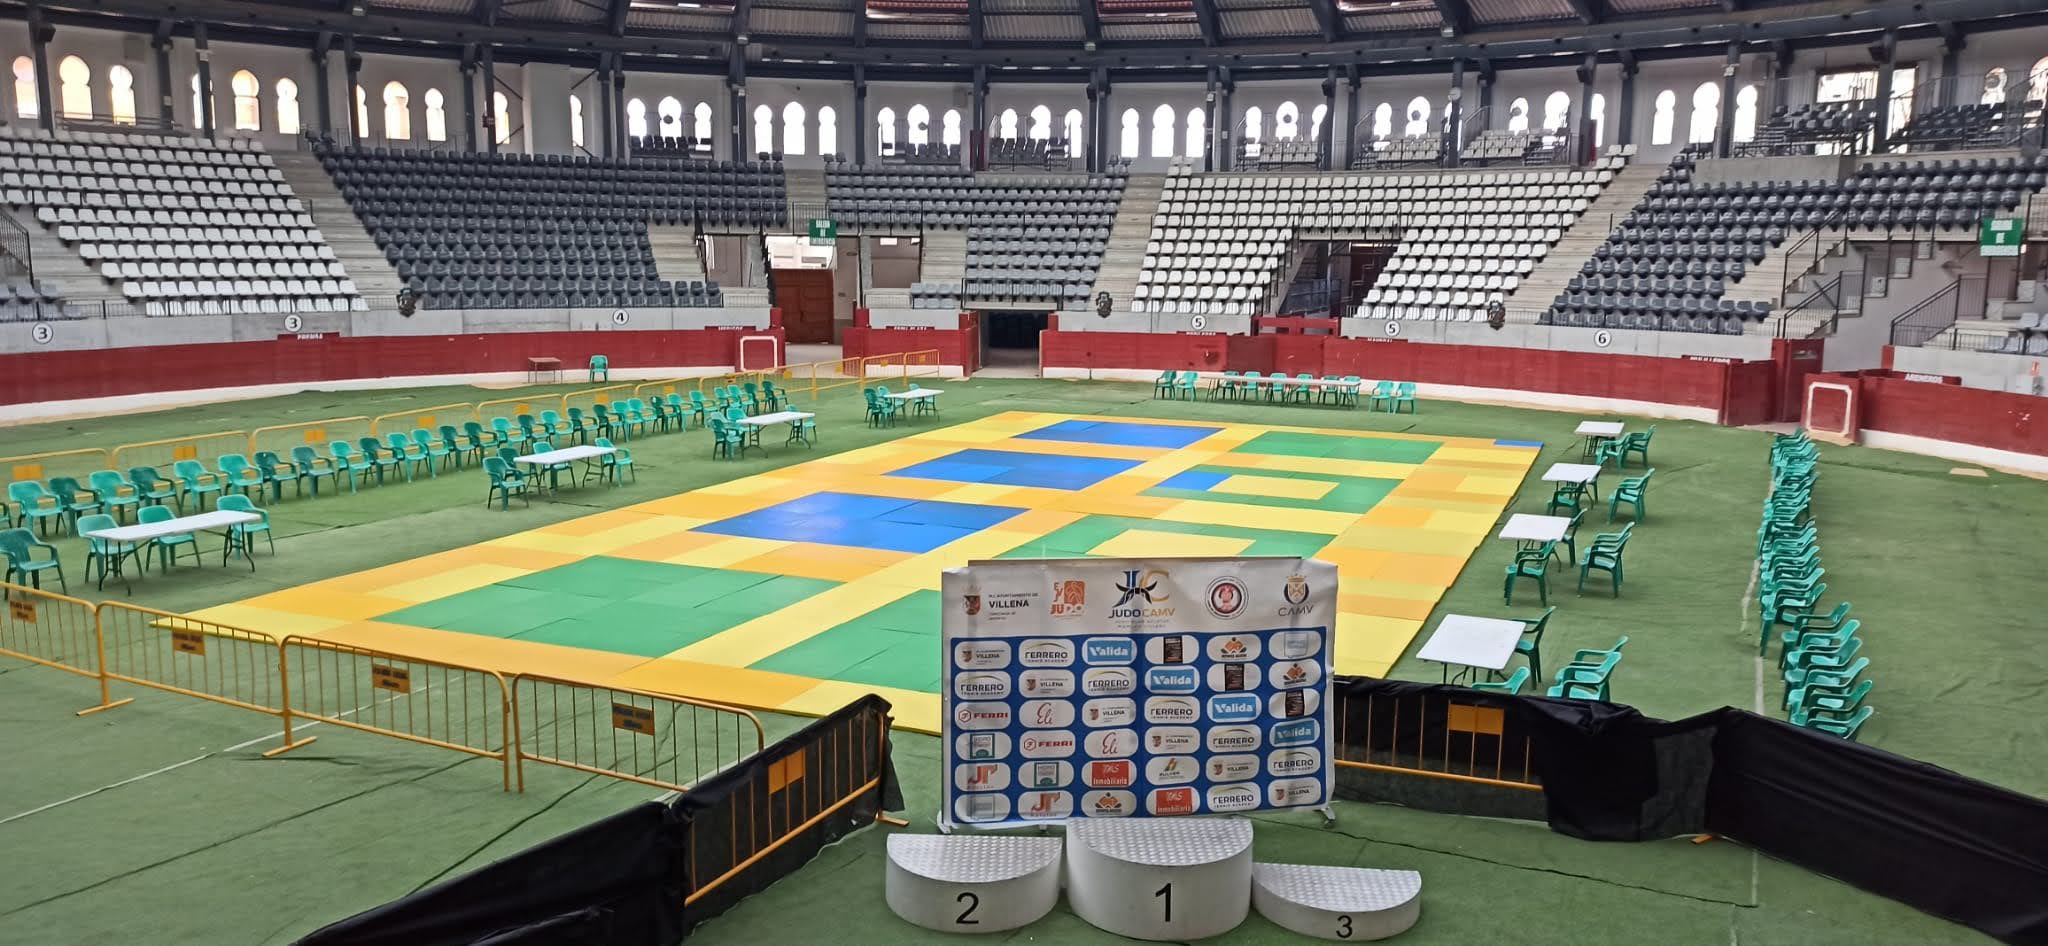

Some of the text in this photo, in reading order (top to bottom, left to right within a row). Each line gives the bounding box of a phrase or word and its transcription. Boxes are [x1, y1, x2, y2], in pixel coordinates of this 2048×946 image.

[38, 326, 48, 340] 3
[988, 600, 1030, 609] VILLENA
[1278, 604, 1314, 617] CAMV
[1025, 651, 1068, 659] FERRERO
[960, 683, 1004, 692] FERRERO
[1088, 679, 1130, 688] FERRERO
[1150, 708, 1193, 716] FERRERO
[1213, 794, 1254, 803] FERRERO
[1155, 882, 1173, 923] 1
[955, 891, 980, 925] 2
[1336, 914, 1353, 940] 3
